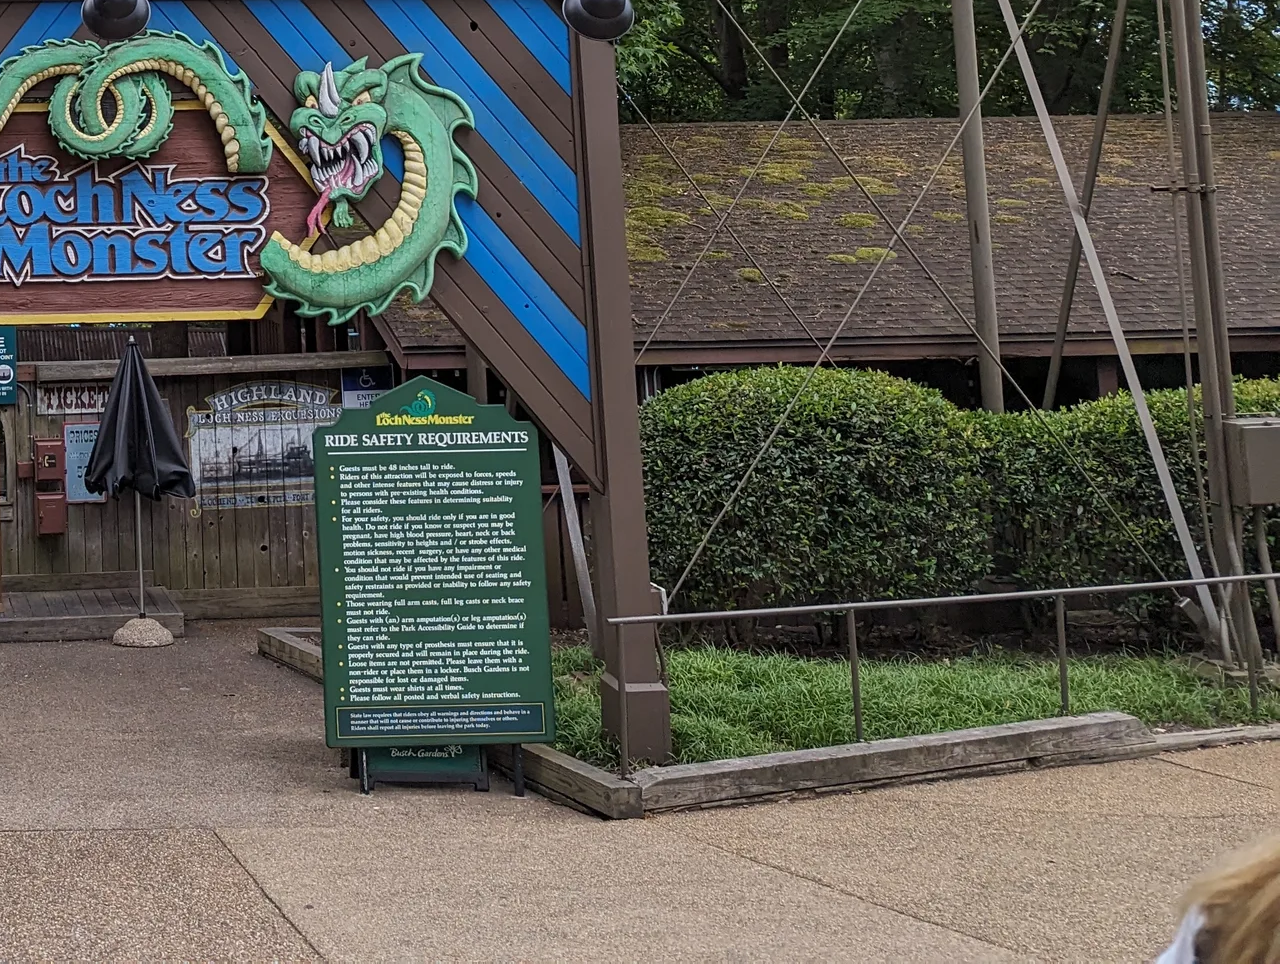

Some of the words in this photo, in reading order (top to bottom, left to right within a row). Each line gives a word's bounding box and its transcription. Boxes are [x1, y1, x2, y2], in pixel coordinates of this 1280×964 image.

[119, 170, 265, 227] Ness
[213, 385, 327, 411] HIGHLAND
[198, 412, 232, 424] LOCH
[237, 412, 264, 422] NESS
[271, 408, 342, 421] EXCURSIONS
[324, 434, 358, 446] RIDE
[361, 433, 413, 445] SAFETY
[417, 431, 528, 446] REQUIREMENTS
[437, 471, 464, 480] exposed
[473, 471, 494, 479] forces,
[495, 470, 516, 479] speeds
[353, 516, 369, 524] your
[370, 515, 391, 523] safety,
[392, 515, 404, 523] you
[442, 513, 457, 522] only
[498, 512, 515, 521] good
[366, 599, 392, 608] wearing
[421, 598, 439, 607] casts,
[453, 598, 464, 606] leg
[403, 693, 424, 702] posted
[461, 692, 480, 701] safety
[481, 691, 520, 699] instructions.
[390, 748, 416, 757] Busch
[417, 748, 448, 758] Gardens
